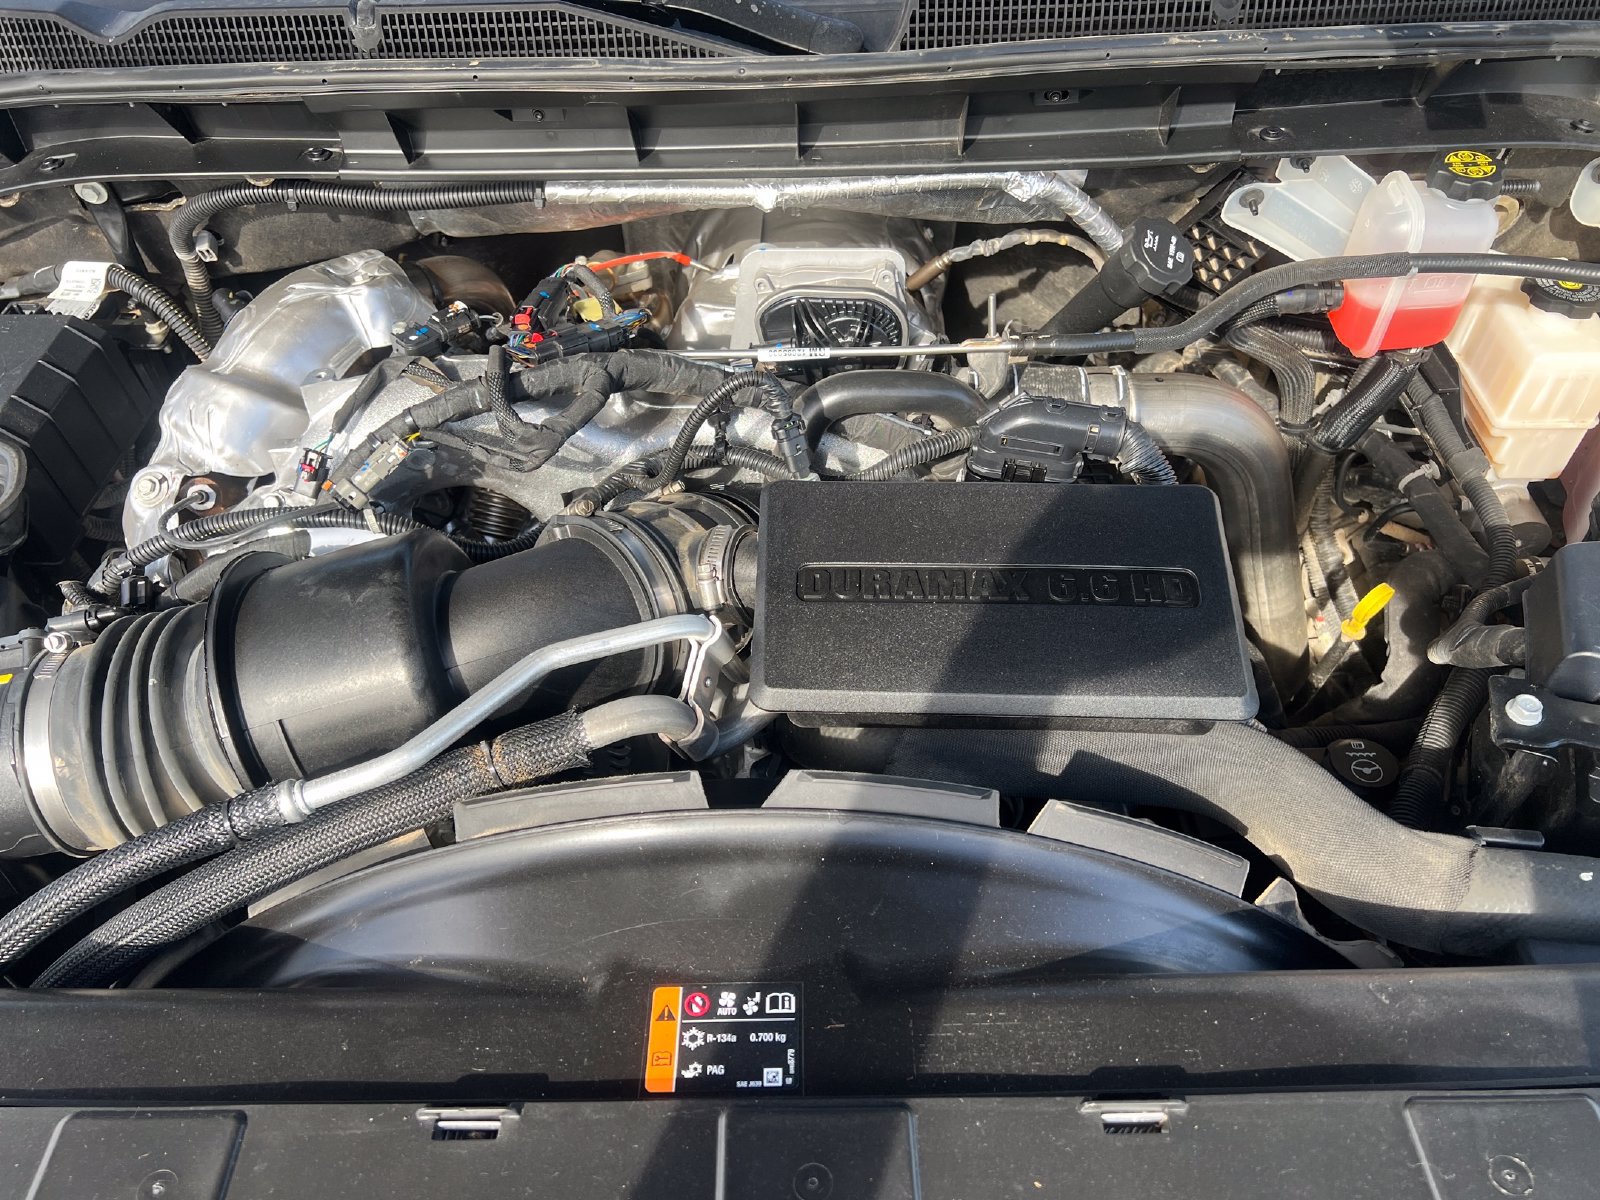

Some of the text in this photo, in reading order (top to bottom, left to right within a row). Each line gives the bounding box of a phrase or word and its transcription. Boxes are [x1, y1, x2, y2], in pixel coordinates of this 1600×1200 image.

[803, 568, 1194, 605] DURAMAX 6.6 HD
[717, 1007, 737, 1016] AUTO
[706, 1032, 786, 1043] R-134a 0.700 kg
[706, 1065, 725, 1076] PAG
